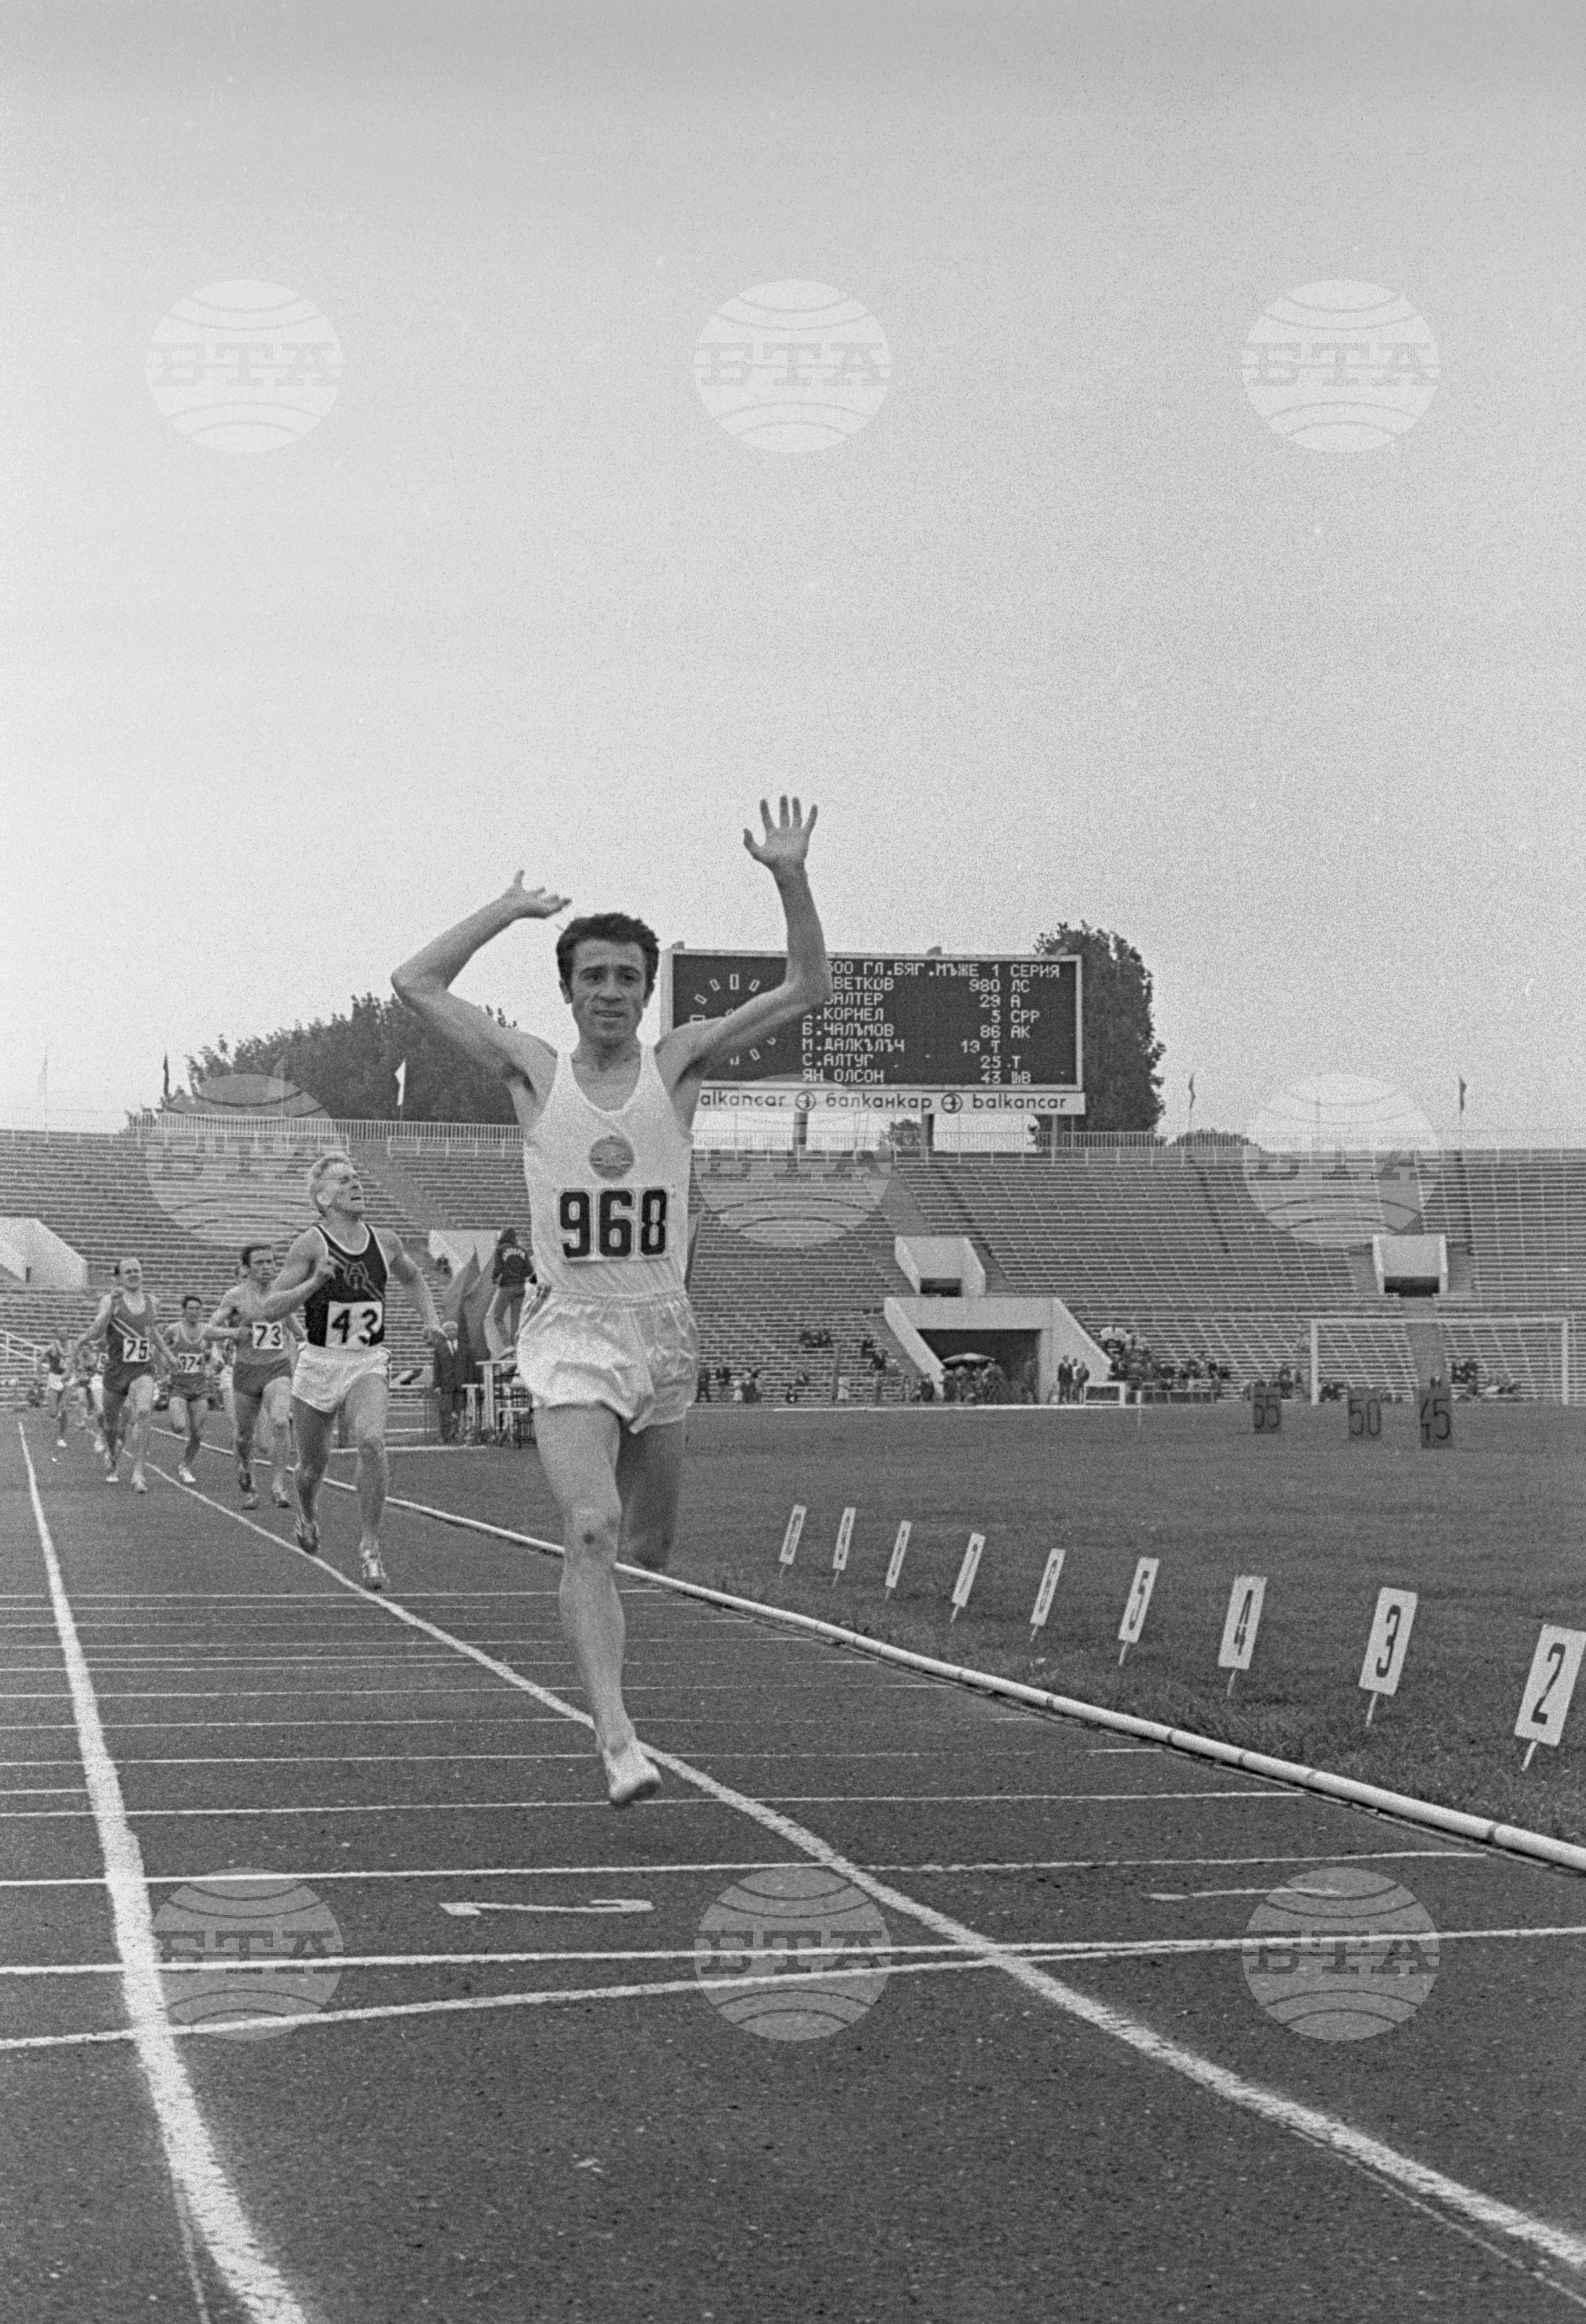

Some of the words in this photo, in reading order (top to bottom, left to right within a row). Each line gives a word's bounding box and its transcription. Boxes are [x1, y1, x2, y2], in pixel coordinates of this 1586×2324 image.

[992, 964, 999, 977] 1
[1010, 964, 1059, 978] СЕРИЯ
[834, 977, 894, 991] ВЕТКОВ
[969, 979, 1000, 992] 980
[980, 995, 1001, 1008] 29
[1011, 995, 1021, 1008] А
[991, 1010, 1000, 1023] 5
[1011, 1010, 1040, 1023] СРР
[980, 1025, 1001, 1038] 86
[1011, 1025, 1030, 1039] АК
[991, 1040, 1000, 1053] Т
[980, 1056, 1001, 1068] 25
[802, 1068, 824, 1082] ЯН
[834, 1069, 883, 1082] ОЛСОН
[980, 1071, 1001, 1084] 43
[701, 1090, 786, 1107] alkancar
[973, 1093, 1066, 1109] balkancar
[560, 1189, 667, 1258] 968
[256, 1325, 281, 1347] 73
[331, 1309, 378, 1344] 43
[126, 1339, 148, 1360] 75
[1348, 1398, 1381, 1436] 50
[1420, 1397, 1450, 1440] 45
[1128, 1570, 1150, 1630] 5
[1234, 1590, 1254, 1656] 4
[1375, 1604, 1401, 1678] 3
[1530, 1642, 1566, 1725] 2
